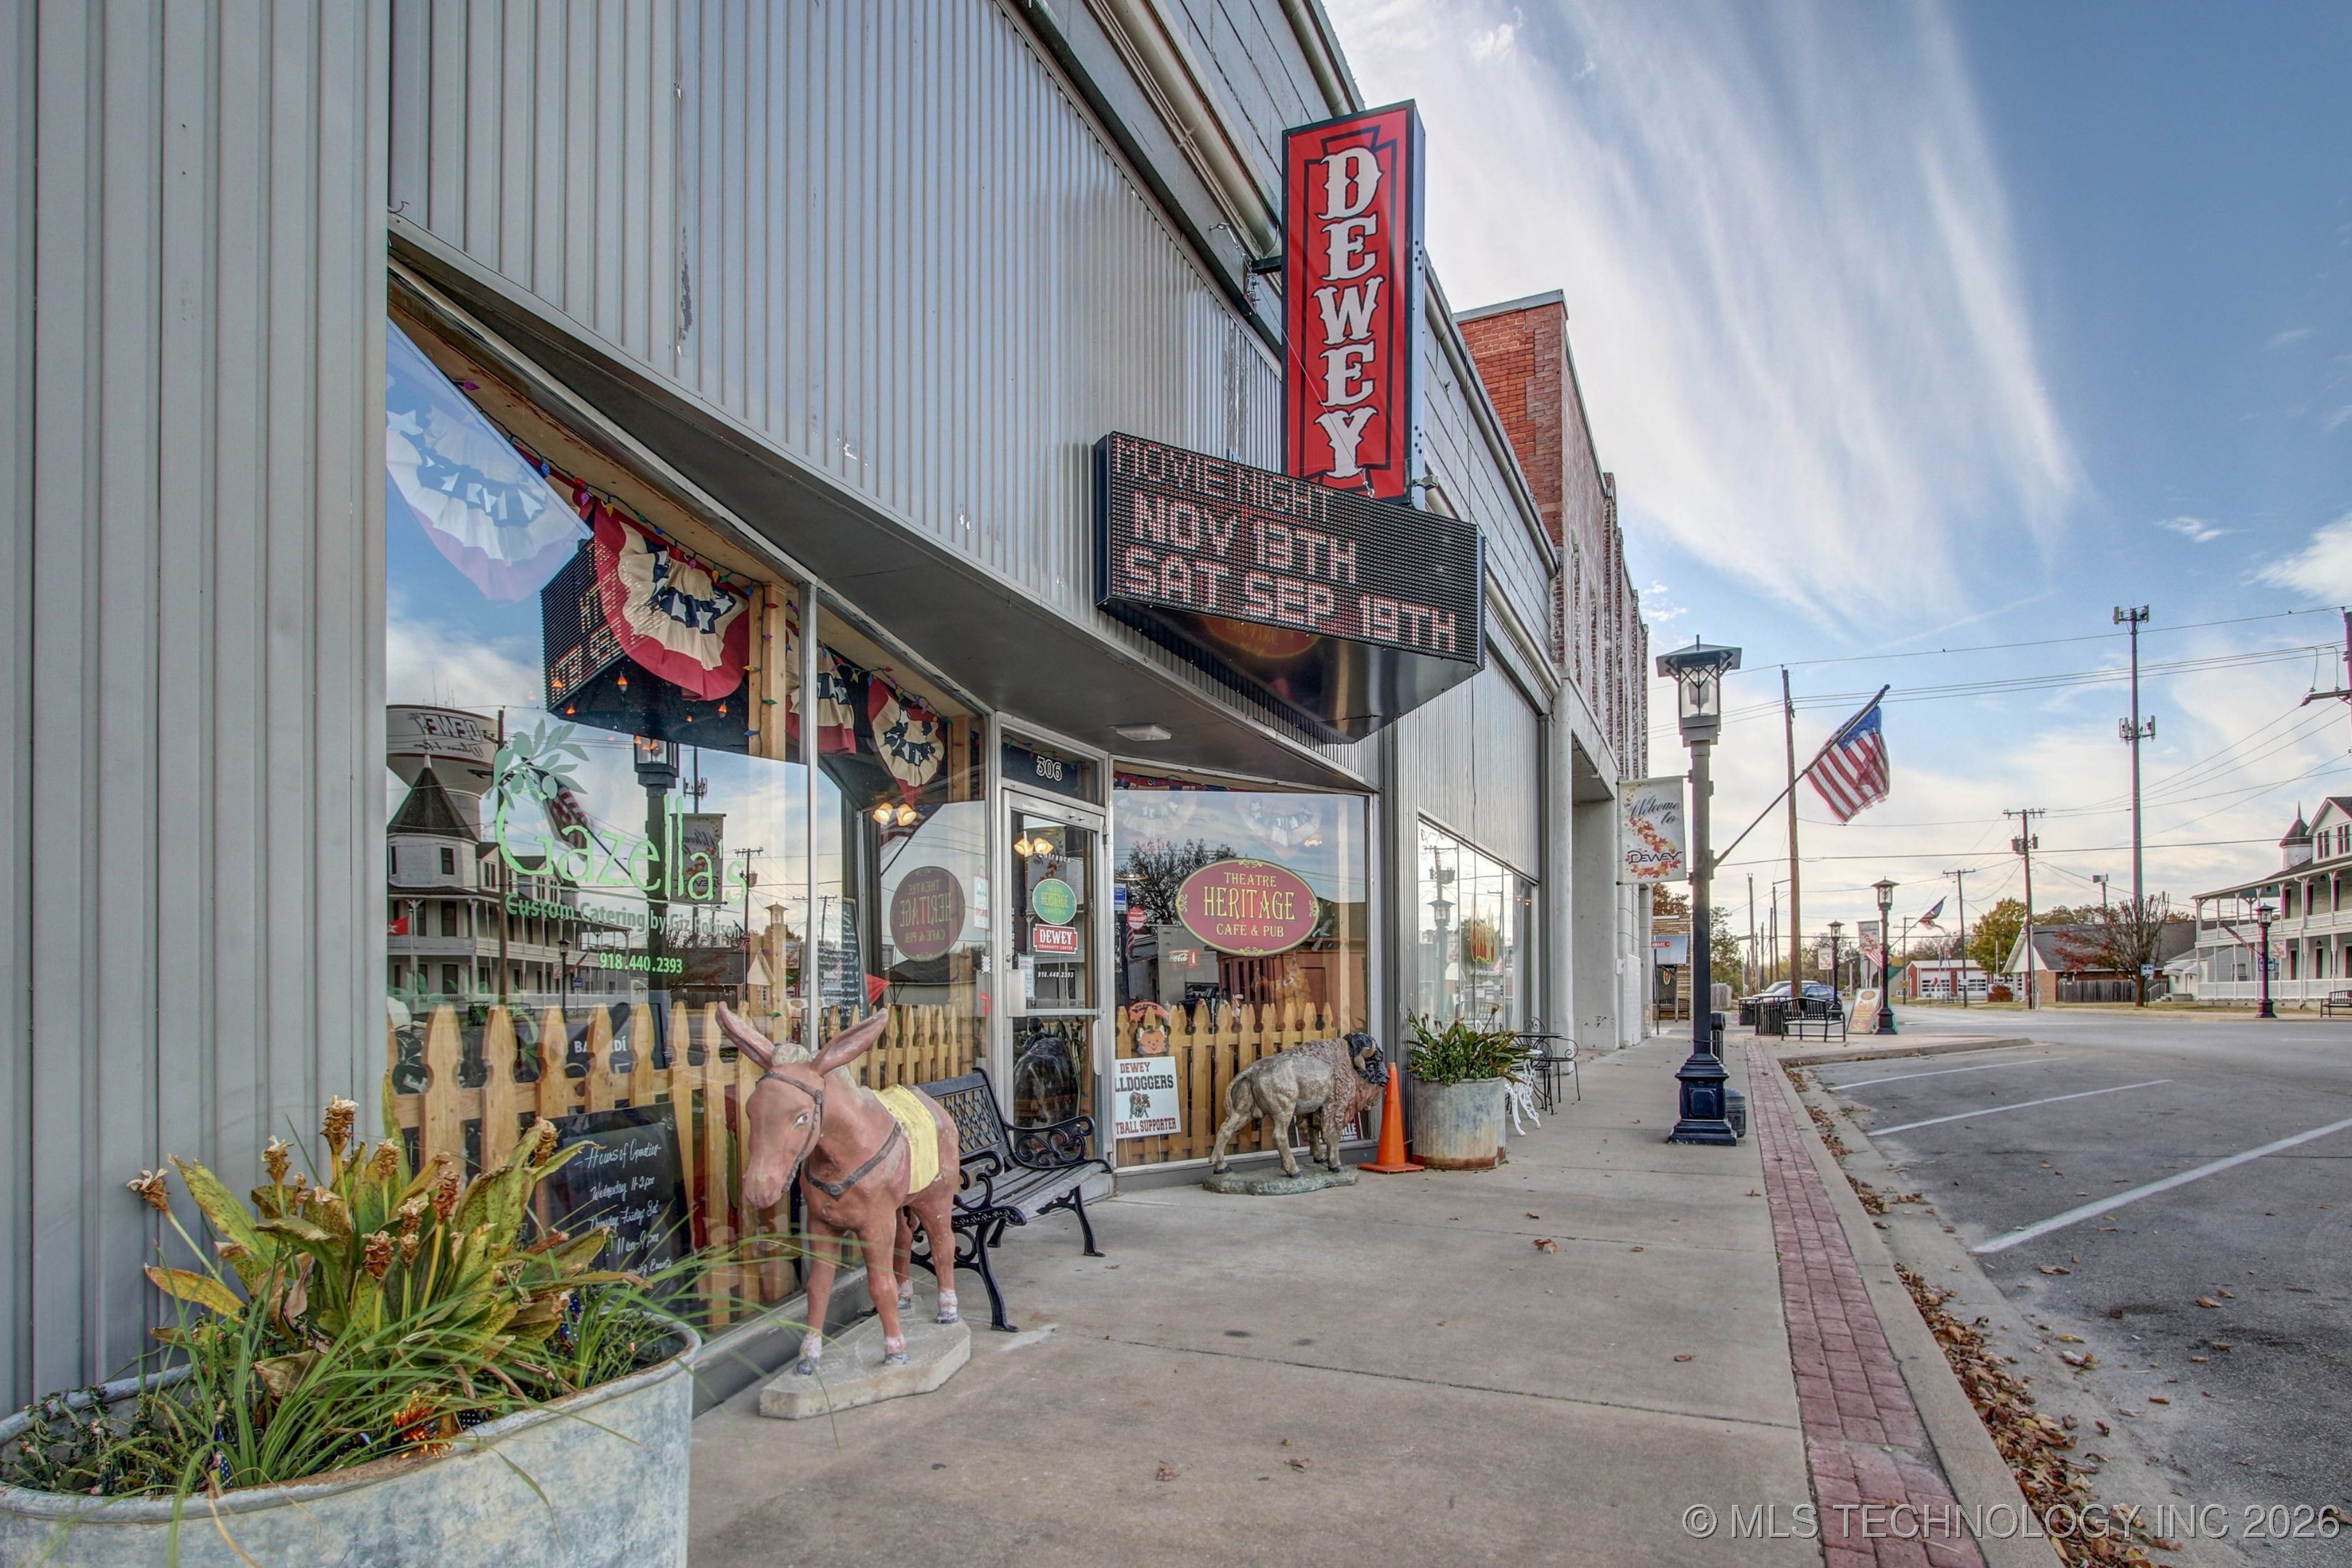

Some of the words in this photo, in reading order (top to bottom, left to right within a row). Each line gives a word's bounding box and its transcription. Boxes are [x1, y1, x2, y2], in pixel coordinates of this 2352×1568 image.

[1310, 146, 1384, 479] DEWEY
[1115, 436, 1227, 498] MOVIE
[1236, 465, 1334, 523] NIGHT
[1133, 491, 1238, 557] NOV
[1125, 546, 1230, 609] SAT
[1244, 571, 1336, 627] SEP
[1036, 755, 1063, 782] 306
[1630, 794, 1680, 817] Welcome
[495, 788, 747, 905] Gazella's
[1628, 850, 1683, 865] DEWEY
[1224, 872, 1277, 887] THEATRE
[505, 893, 575, 920] Custom
[580, 902, 646, 933] Catering
[650, 910, 667, 935] by
[669, 914, 691, 932] Giz
[694, 916, 740, 938] Robison
[1204, 886, 1296, 920] HERITAGE
[1040, 929, 1072, 945] DEWEY
[1217, 921, 1247, 936] CAFÉ
[1251, 925, 1259, 936] &
[1263, 926, 1284, 937] PUB
[599, 952, 683, 973] 918.440.2393
[1120, 1062, 1150, 1073] DEWEY
[1140, 1117, 1177, 1132] SUPPORTER
[619, 1143, 629, 1169] of
